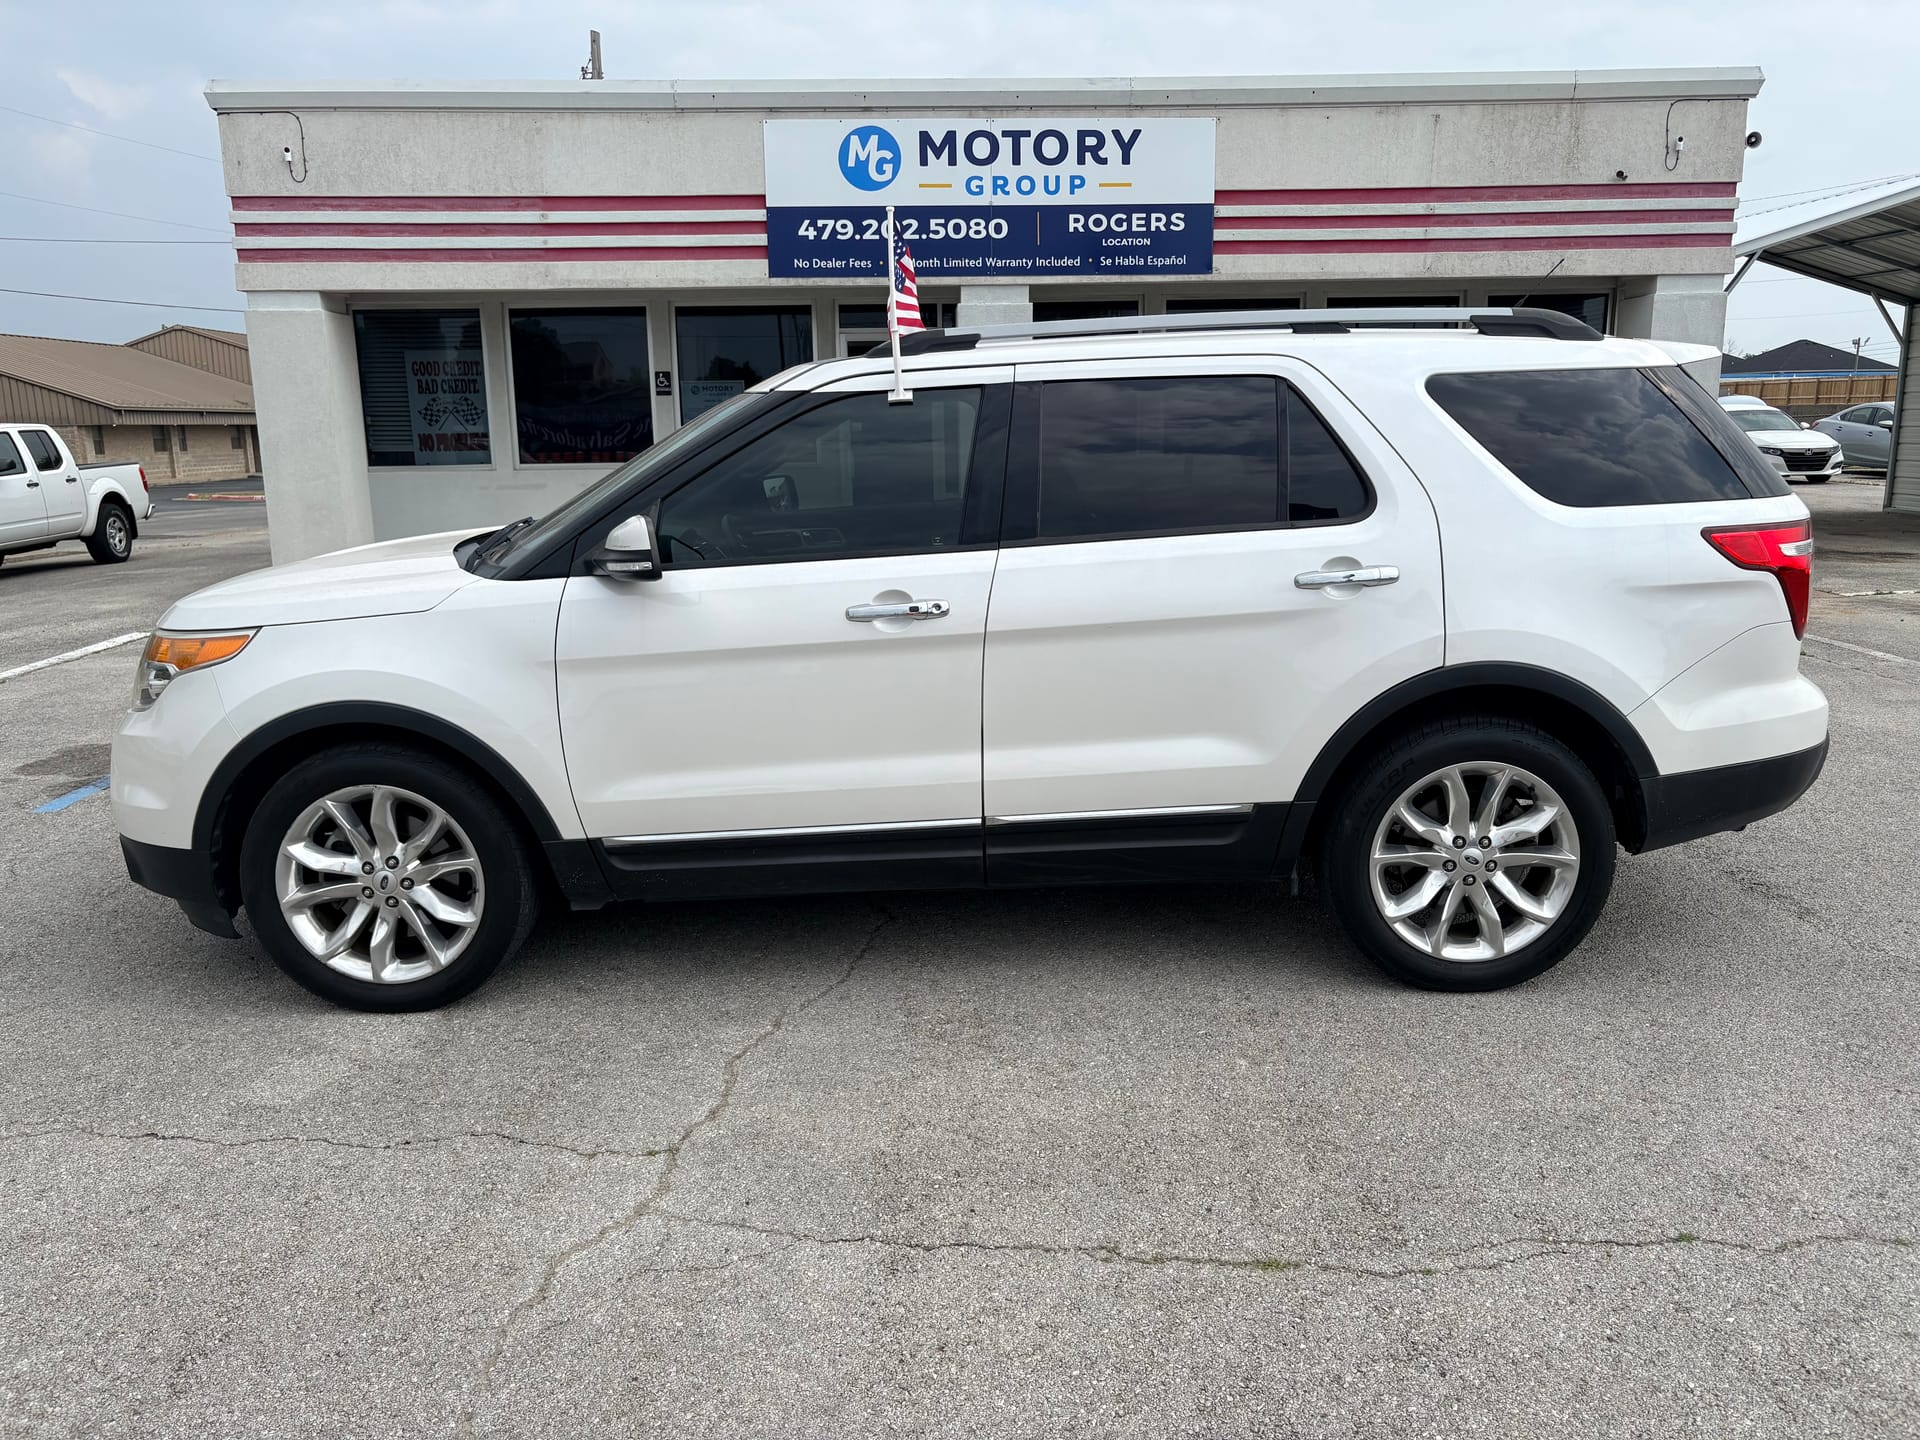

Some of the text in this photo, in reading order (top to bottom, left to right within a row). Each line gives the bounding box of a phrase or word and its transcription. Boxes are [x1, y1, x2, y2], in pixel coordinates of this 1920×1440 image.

[918, 129, 1142, 167] MOTORY
[847, 134, 894, 182] MG
[965, 175, 1086, 196] GROUP
[1068, 212, 1186, 233] ROGERS
[1102, 238, 1151, 246] LOCATION
[794, 257, 872, 268] No Dealer Fees
[943, 256, 982, 268] Limited
[985, 257, 1032, 269] Warranty
[1036, 255, 1081, 267] Included
[1100, 254, 1187, 268] Se Habla Español
[411, 360, 440, 377] GOOD
[416, 379, 439, 395] BAD
[417, 432, 435, 452] NO
